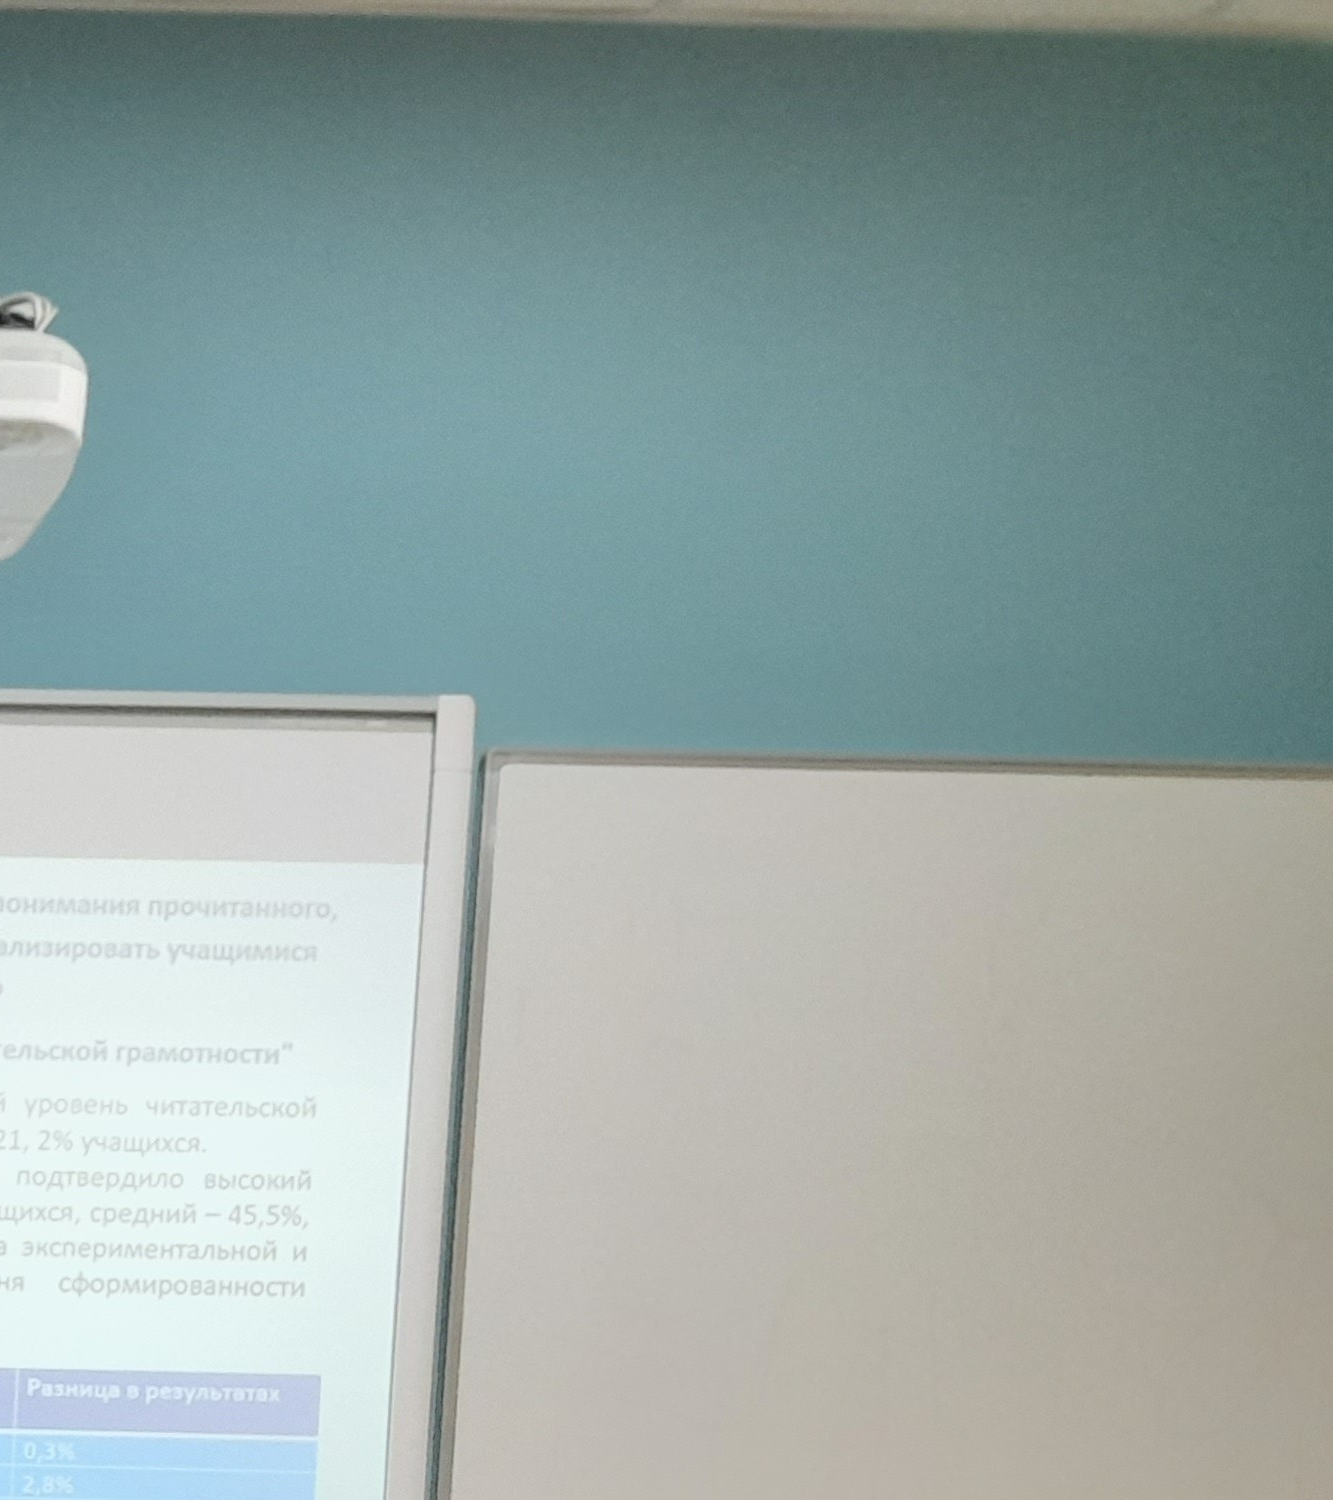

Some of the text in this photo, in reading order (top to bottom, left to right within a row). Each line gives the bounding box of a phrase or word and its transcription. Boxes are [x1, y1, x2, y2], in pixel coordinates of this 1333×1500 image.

[148, 899, 337, 923] прочитанного,
[167, 942, 317, 966] учащимися
[116, 1042, 293, 1067] грамотности"
[25, 1097, 128, 1119] уровень
[146, 1095, 317, 1119] читательской
[38, 1129, 73, 1152] 2%
[81, 1136, 206, 1157] учащихся.
[16, 1169, 184, 1193] подтвердило
[204, 1168, 312, 1191] высокий
[90, 1203, 197, 1228] средний
[228, 1203, 308, 1230] 45,5%,
[22, 1239, 277, 1262] экспериментальной
[293, 1245, 307, 1262] и
[58, 1271, 305, 1300] сформированности
[27, 1378, 280, 1406] Разница в результатах
[23, 1439, 76, 1462] 0,3%
[22, 1475, 74, 1496] 2,8%
